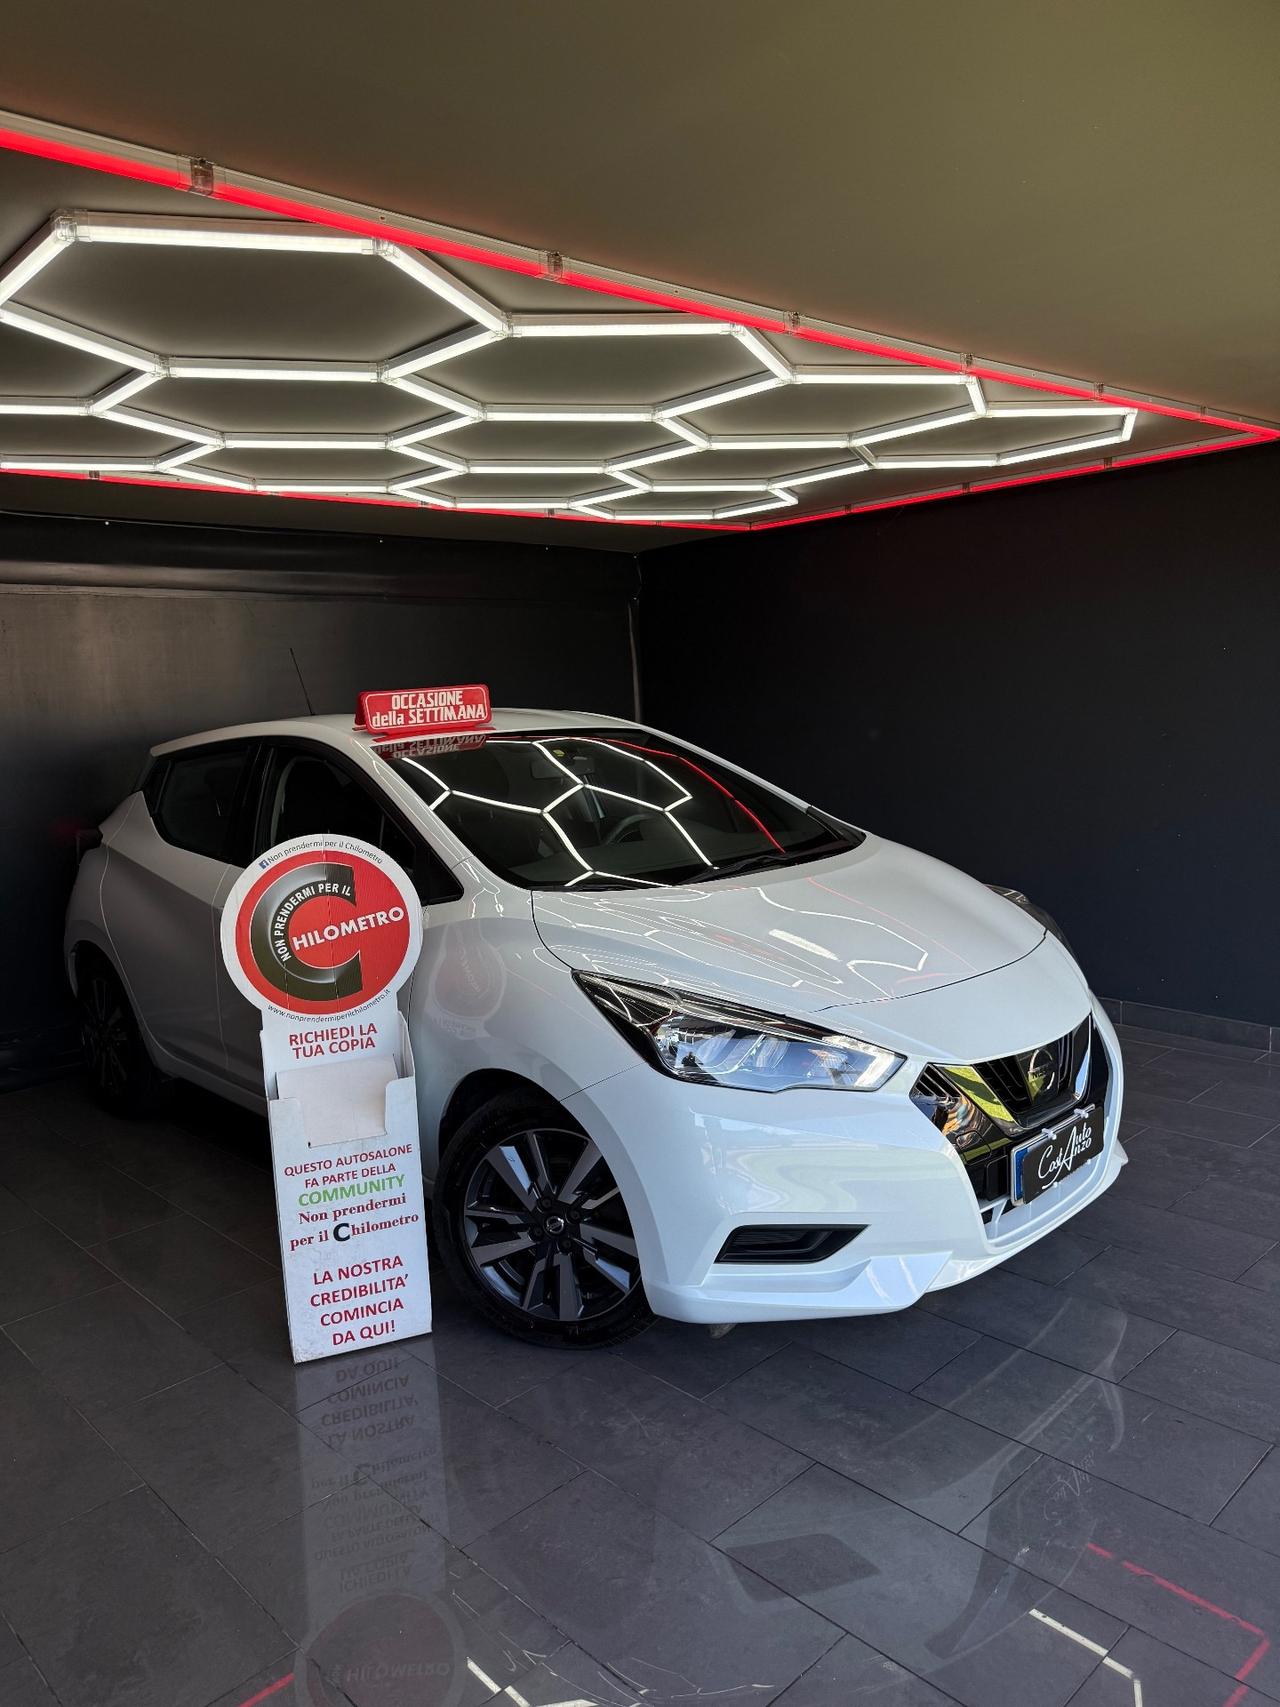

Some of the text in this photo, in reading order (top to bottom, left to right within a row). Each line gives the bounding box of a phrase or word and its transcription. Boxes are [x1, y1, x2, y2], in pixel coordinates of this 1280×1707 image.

[391, 690, 464, 710] OCCASIONE
[372, 704, 486, 727] della SETTIMANA
[268, 851, 284, 865] Non
[283, 840, 323, 857] prendermi
[324, 840, 337, 848] per
[345, 842, 383, 865] Chilometro
[274, 882, 352, 962] NON PRENDERMI PER IL
[289, 1022, 378, 1047] RICHIEDI LA
[292, 1036, 376, 1060] TUA COPIA
[284, 1143, 413, 1177] QUESTO AUTOSALONE
[304, 1163, 397, 1189] FA PARTE DELLA
[298, 1174, 405, 1207] COMMUNITY
[299, 1192, 407, 1225] Non prendermi
[290, 1213, 419, 1251] per il Chilometro
[313, 1255, 404, 1286] LA NOSTRA
[320, 1297, 404, 1327] COMINCIA
[332, 1319, 396, 1346] DA QUI!
